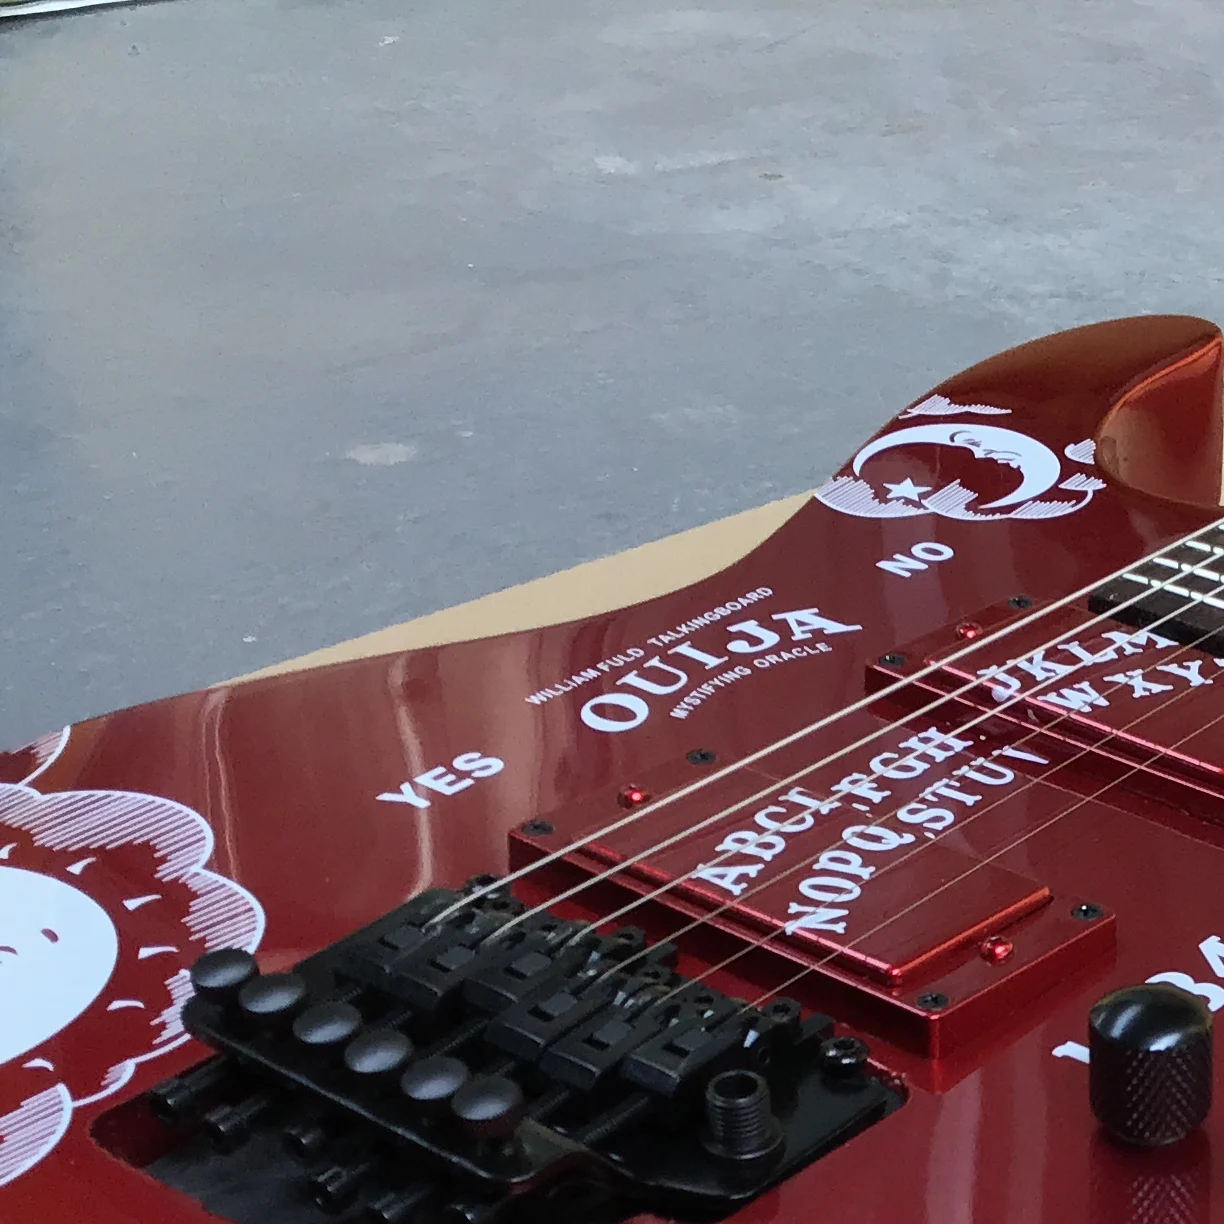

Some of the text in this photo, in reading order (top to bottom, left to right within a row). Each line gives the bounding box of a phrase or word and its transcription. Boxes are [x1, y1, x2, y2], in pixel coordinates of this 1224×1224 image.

[876, 541, 955, 579] NO
[524, 668, 601, 705] WILLIAM
[596, 647, 645, 673] FULD
[580, 607, 863, 733] OUIJA
[669, 642, 833, 720] MYSTIFYING ORACLE
[376, 752, 505, 811] YES
